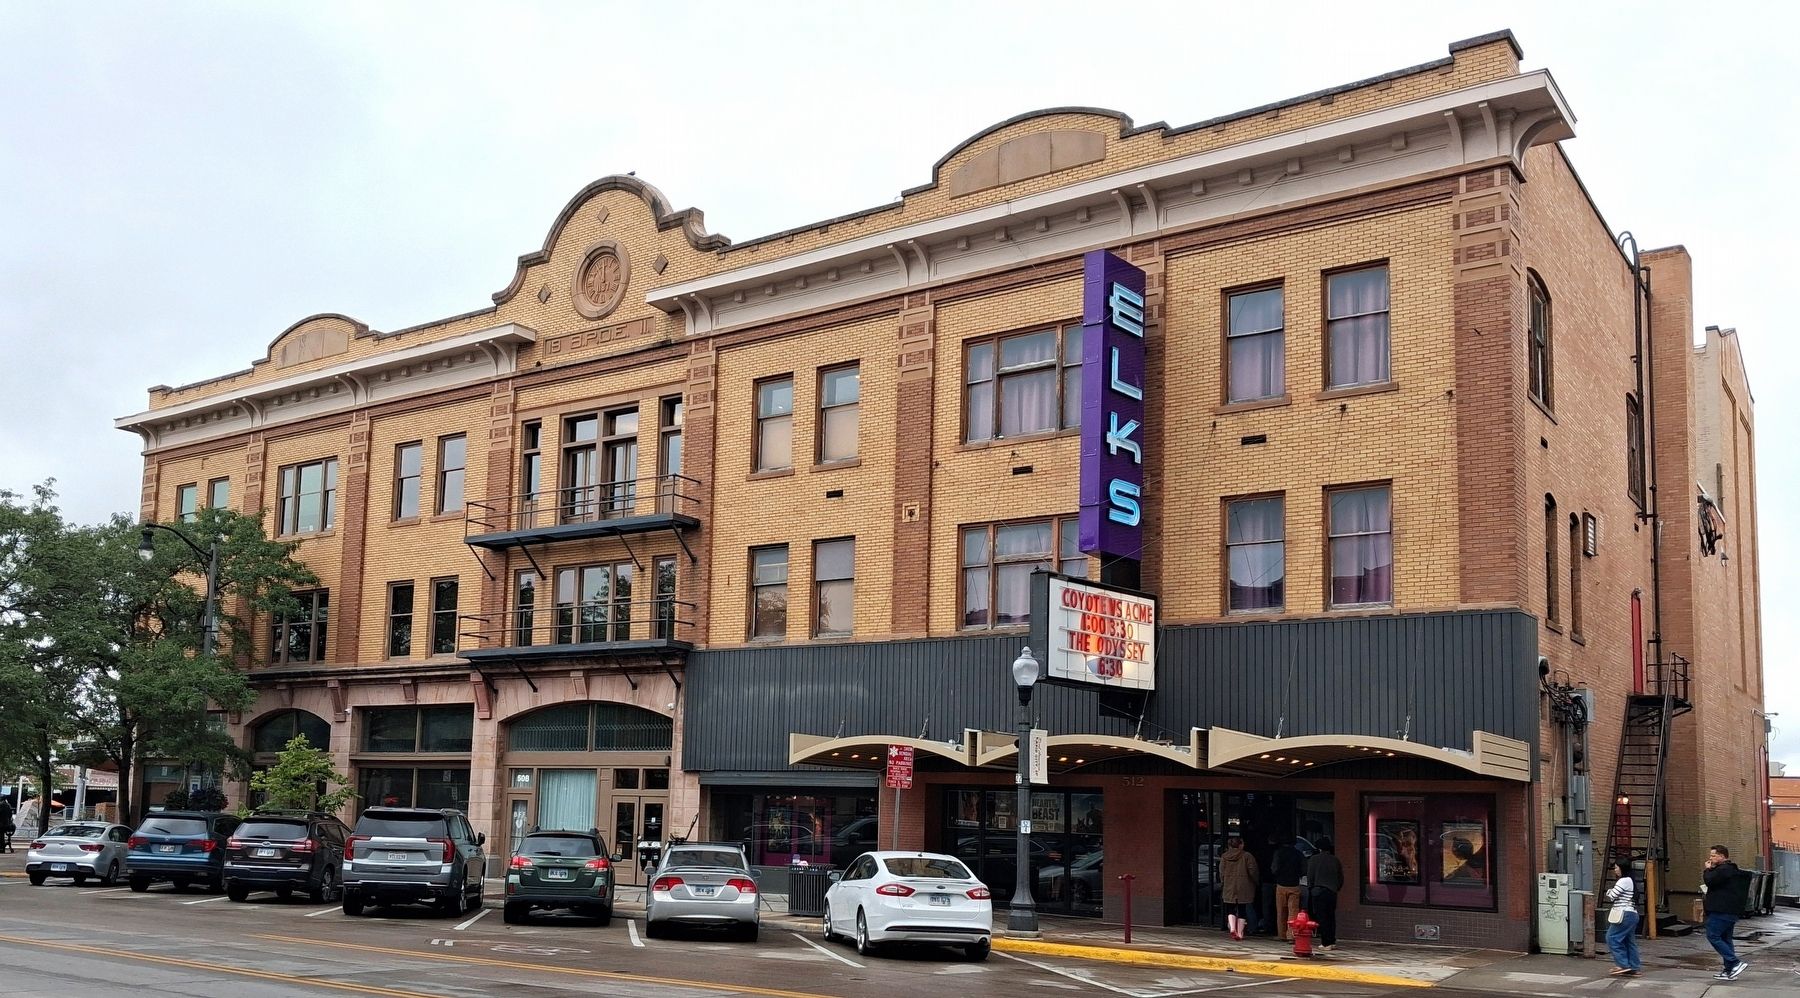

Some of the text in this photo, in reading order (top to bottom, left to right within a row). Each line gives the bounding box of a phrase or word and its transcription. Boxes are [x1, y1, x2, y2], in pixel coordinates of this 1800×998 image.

[1106, 281, 1145, 528] ELKS
[1063, 588, 1153, 624] COYOTE VS ACME
[1110, 619, 1134, 641] 3:30
[1069, 631, 1145, 661] THE ODYSSEY
[1098, 658, 1123, 678] 6:30
[517, 774, 530, 782] 508
[1122, 776, 1144, 787] 512
[1032, 807, 1060, 821] BEAST
